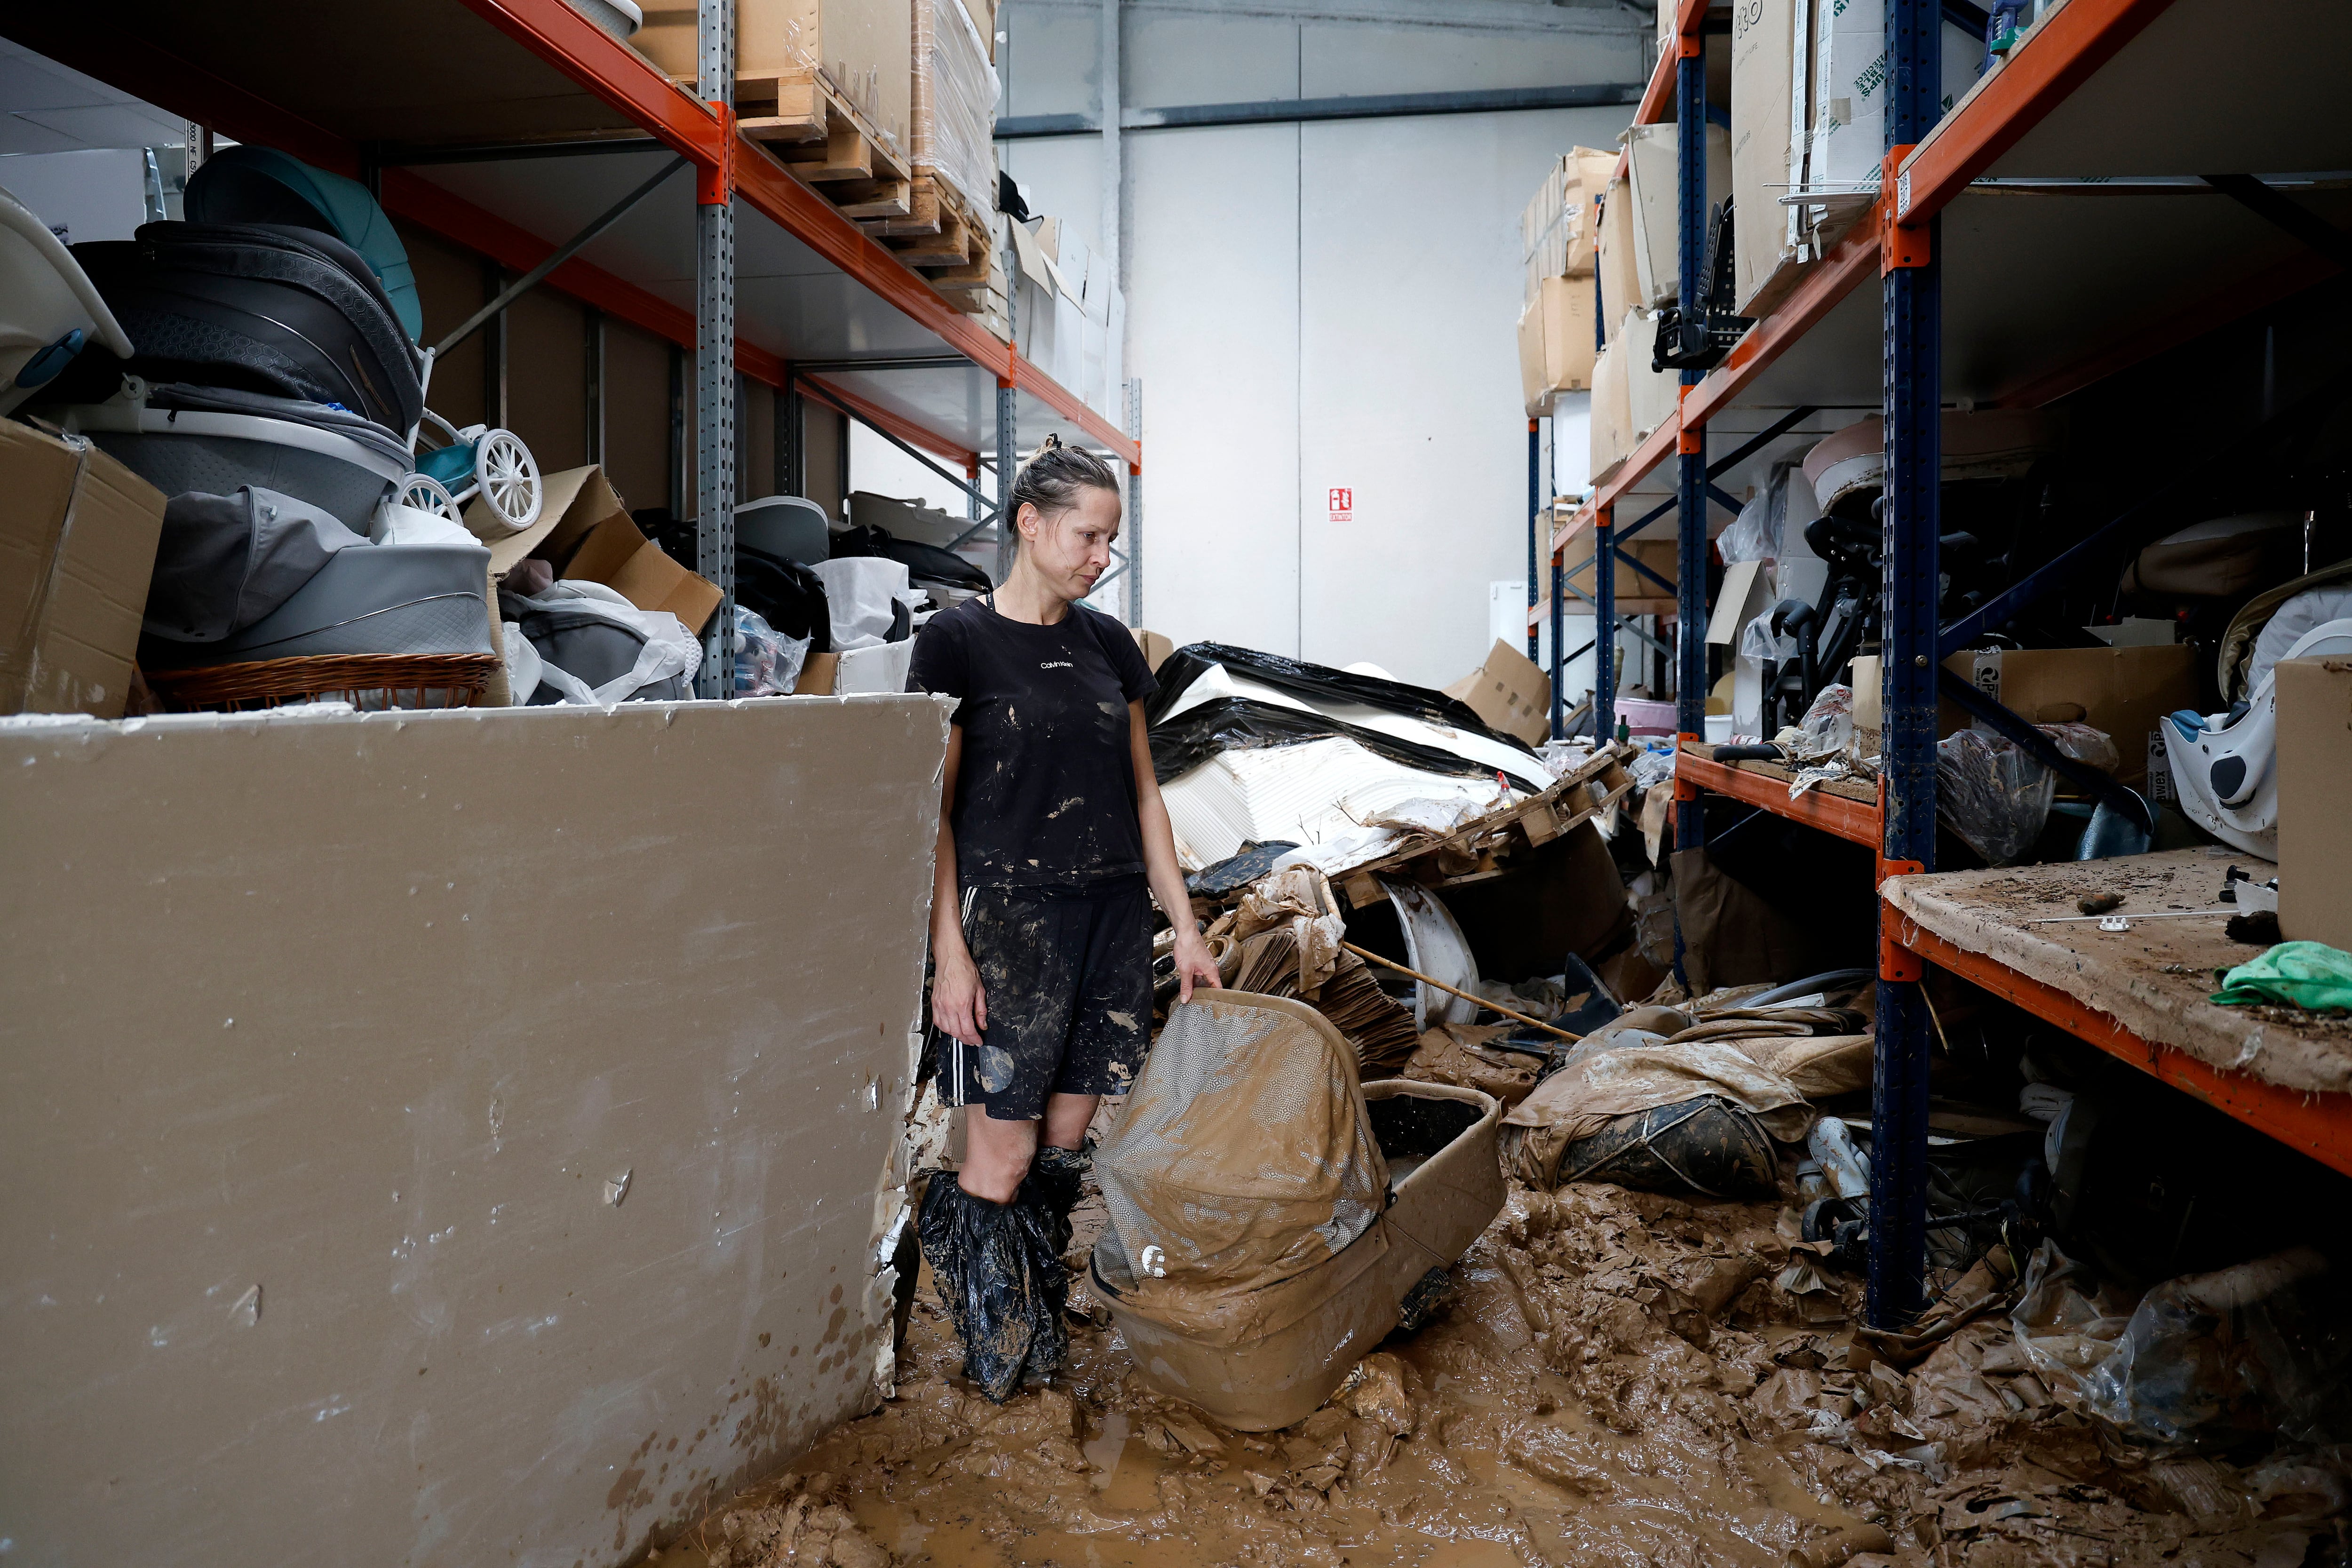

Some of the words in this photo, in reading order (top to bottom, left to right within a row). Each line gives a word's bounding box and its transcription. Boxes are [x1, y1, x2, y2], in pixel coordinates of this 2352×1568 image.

[1857, 62, 1884, 91] EBLE
[1861, 72, 1884, 98] UPŚ
[189, 146, 197, 156] NF
[2155, 771, 2166, 802] awex
